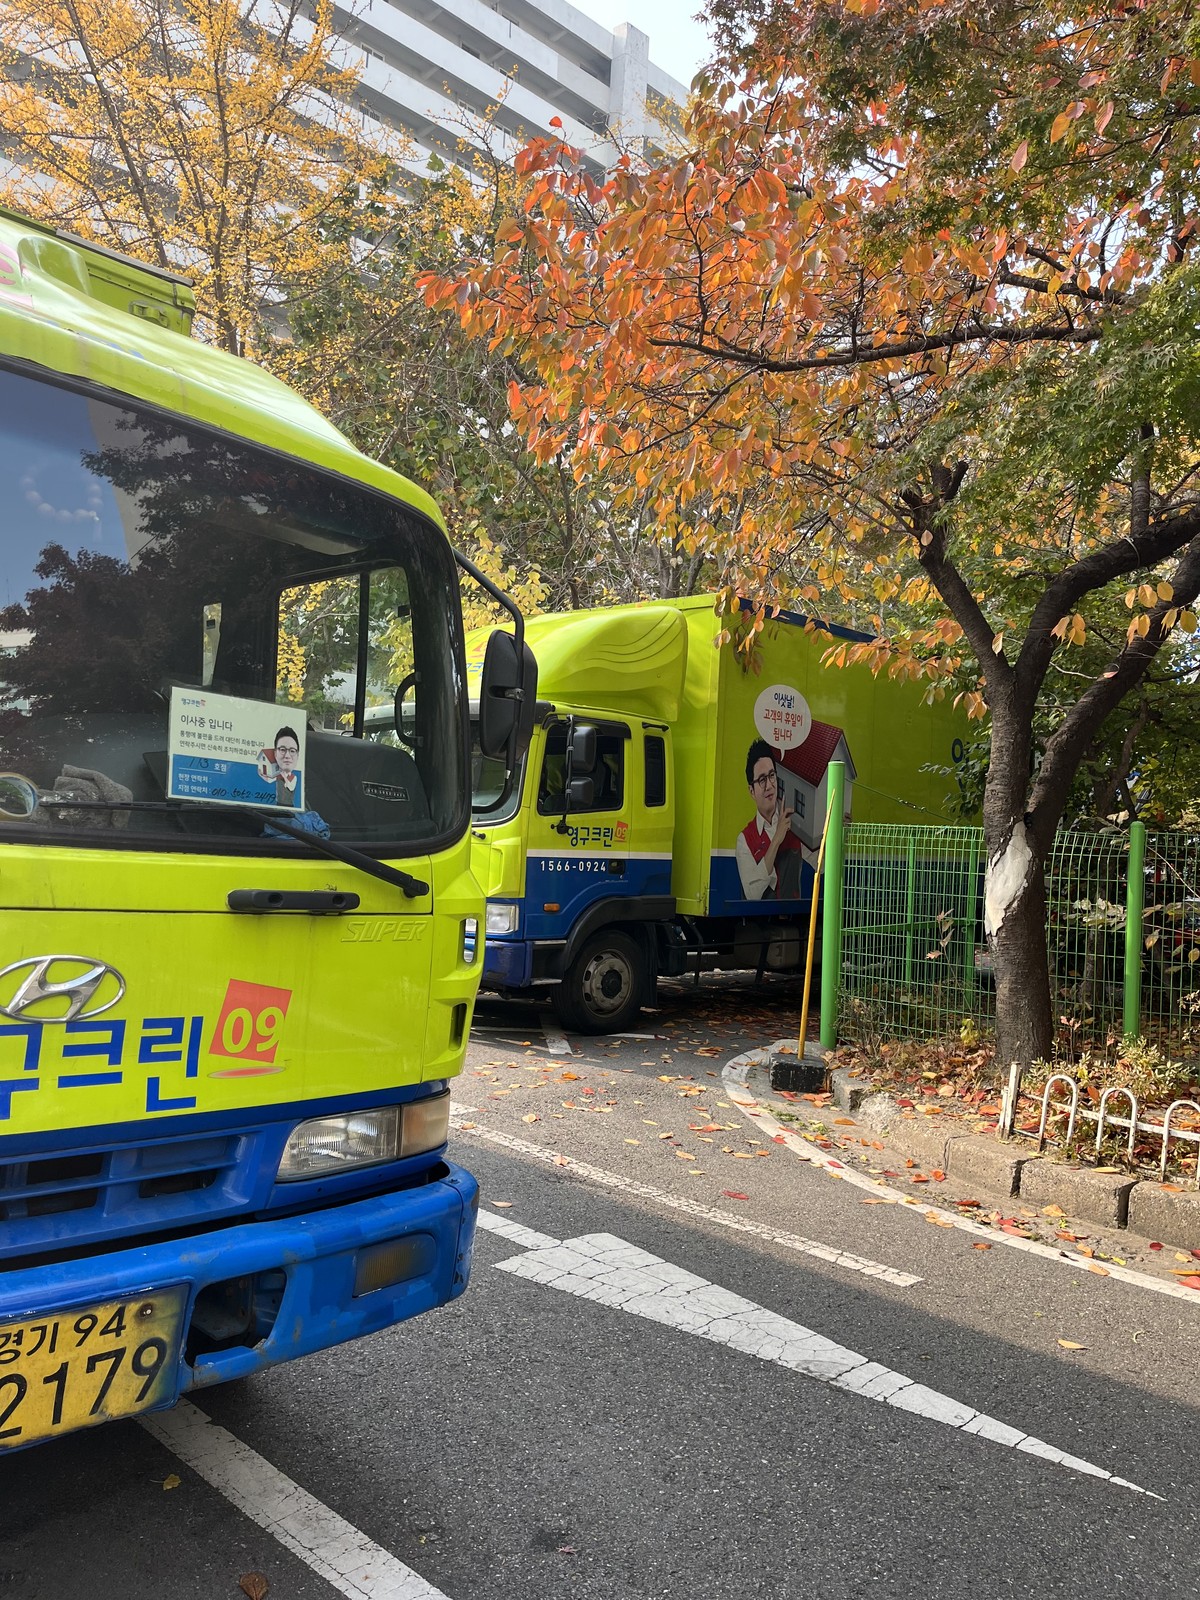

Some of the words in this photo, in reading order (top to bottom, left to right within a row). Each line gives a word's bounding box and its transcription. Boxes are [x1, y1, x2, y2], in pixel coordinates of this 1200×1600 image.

[180, 714, 206, 728] 이사중
[208, 718, 233, 731] 입니다
[763, 709, 783, 723] 고객의
[785, 712, 803, 727] 휴일이
[225, 736, 241, 745] 대단히
[241, 738, 265, 748] 죄송합니다
[773, 728, 792, 741] 됩니다
[179, 740, 206, 750] 연락주시면
[207, 743, 223, 752] 신속히
[214, 763, 227, 772] 호점
[178, 773, 190, 782] 현장
[190, 774, 208, 783] 연락처
[178, 784, 189, 792] 지점
[190, 785, 208, 794] 연락처
[567, 826, 613, 847] 영구크린
[540, 860, 606, 872] 1566-0924
[341, 921, 428, 942] SUPER
[222, 1006, 286, 1054] 09
[73, 1305, 127, 1347] 94
[0, 1336, 168, 1440] 2179
